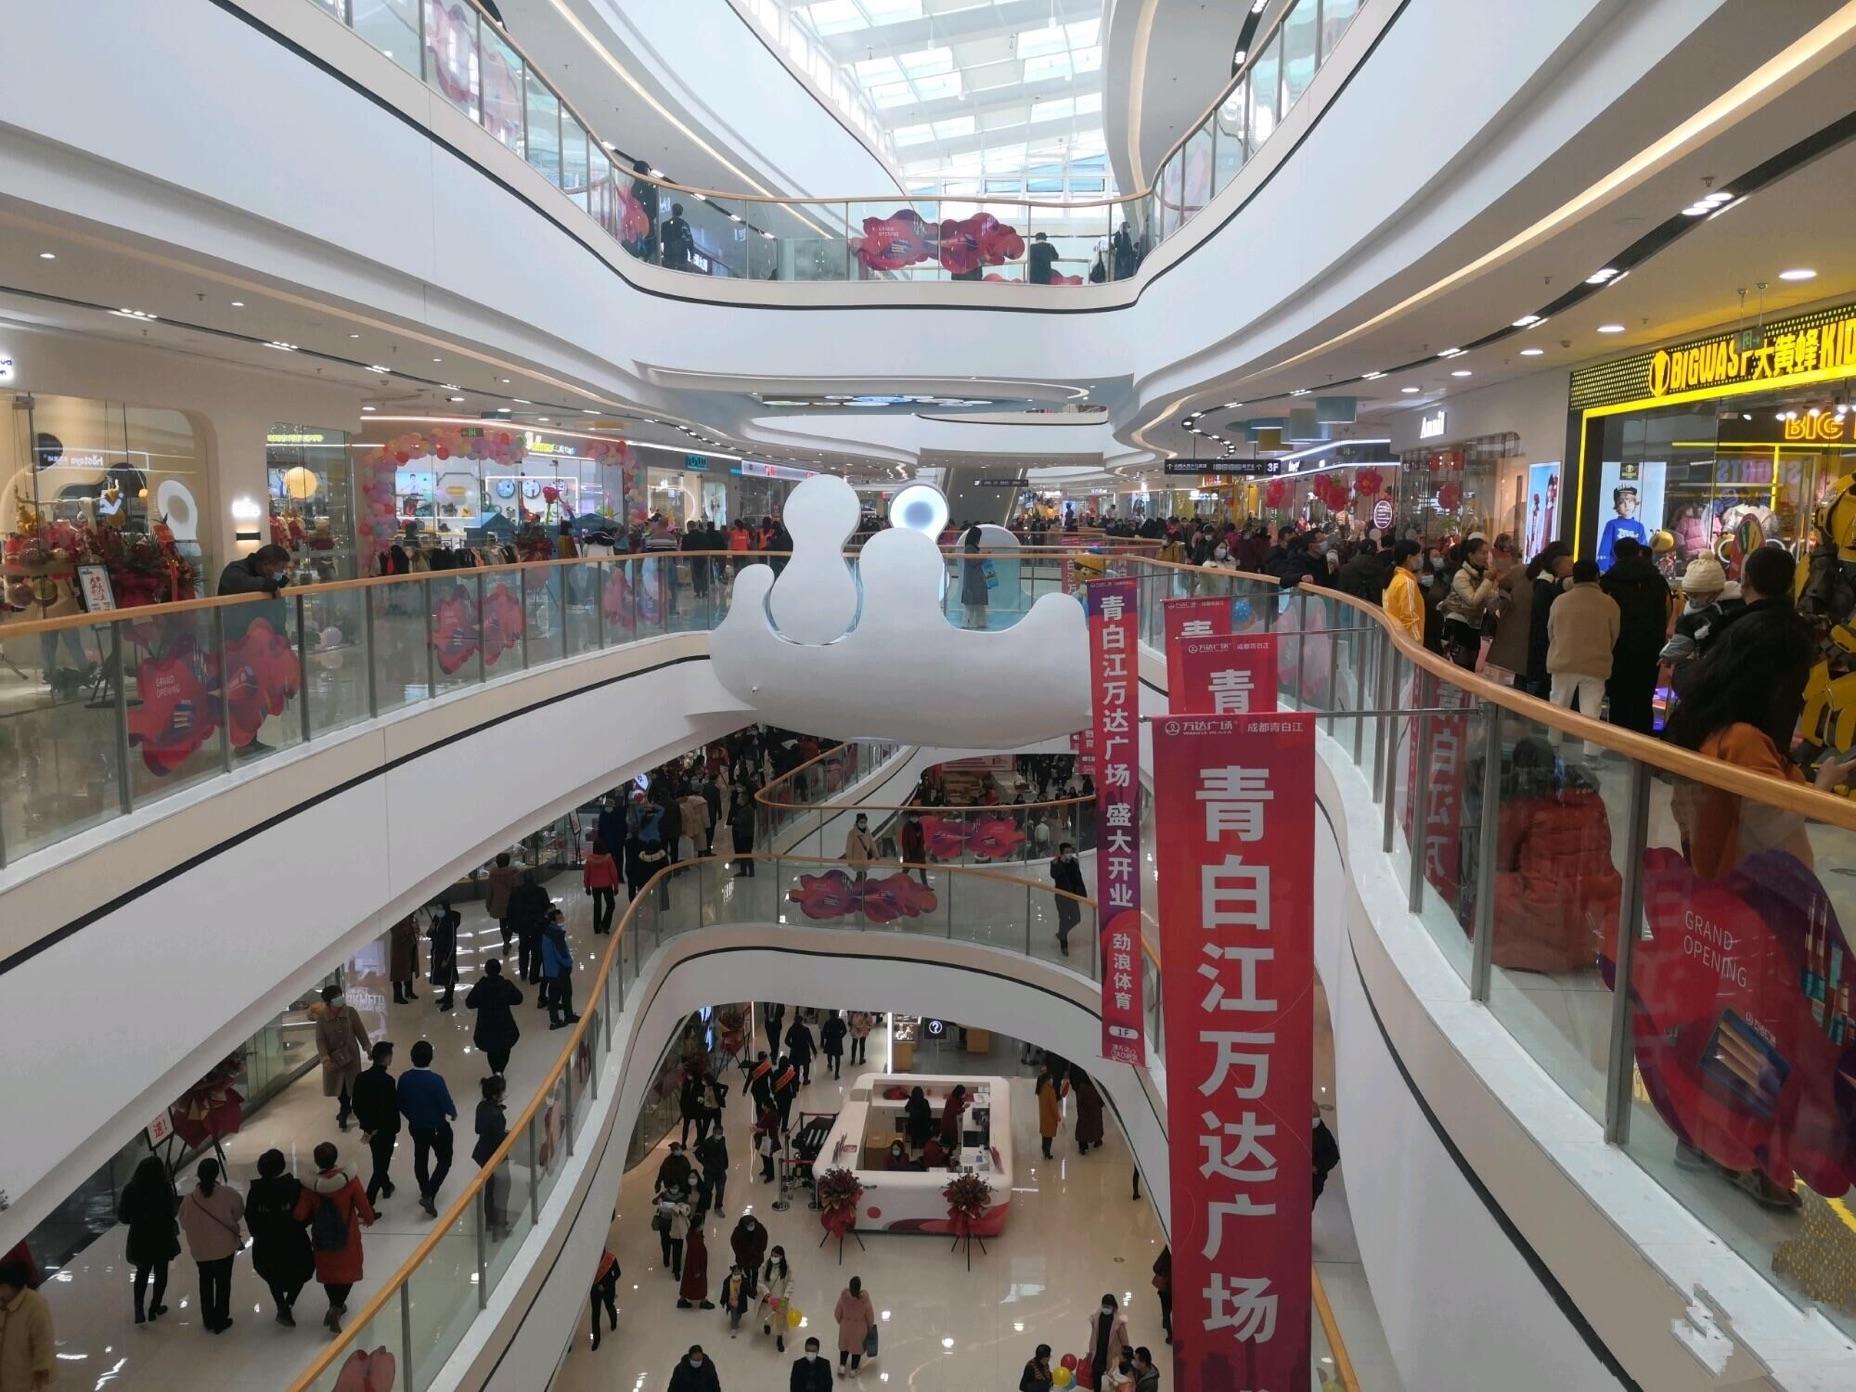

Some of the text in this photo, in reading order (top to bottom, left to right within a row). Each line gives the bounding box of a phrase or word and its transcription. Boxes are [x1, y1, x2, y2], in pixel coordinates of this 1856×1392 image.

[1753, 328, 1819, 380] 大黄蜂
[1785, 411, 1844, 440] BIG
[1267, 462, 1280, 473] 3F
[1099, 594, 1131, 787] 青白江万达广场
[1208, 668, 1255, 714] 青
[1183, 720, 1233, 731] 万达广场
[1247, 721, 1304, 733] 成都青白江
[1106, 802, 1134, 908] 盛大开业
[1685, 911, 1733, 951] GRAND
[1112, 932, 1133, 1011] 劲浪体育
[1683, 935, 1747, 988] OPENING
[1195, 765, 1280, 1345] 青白江万达广场
